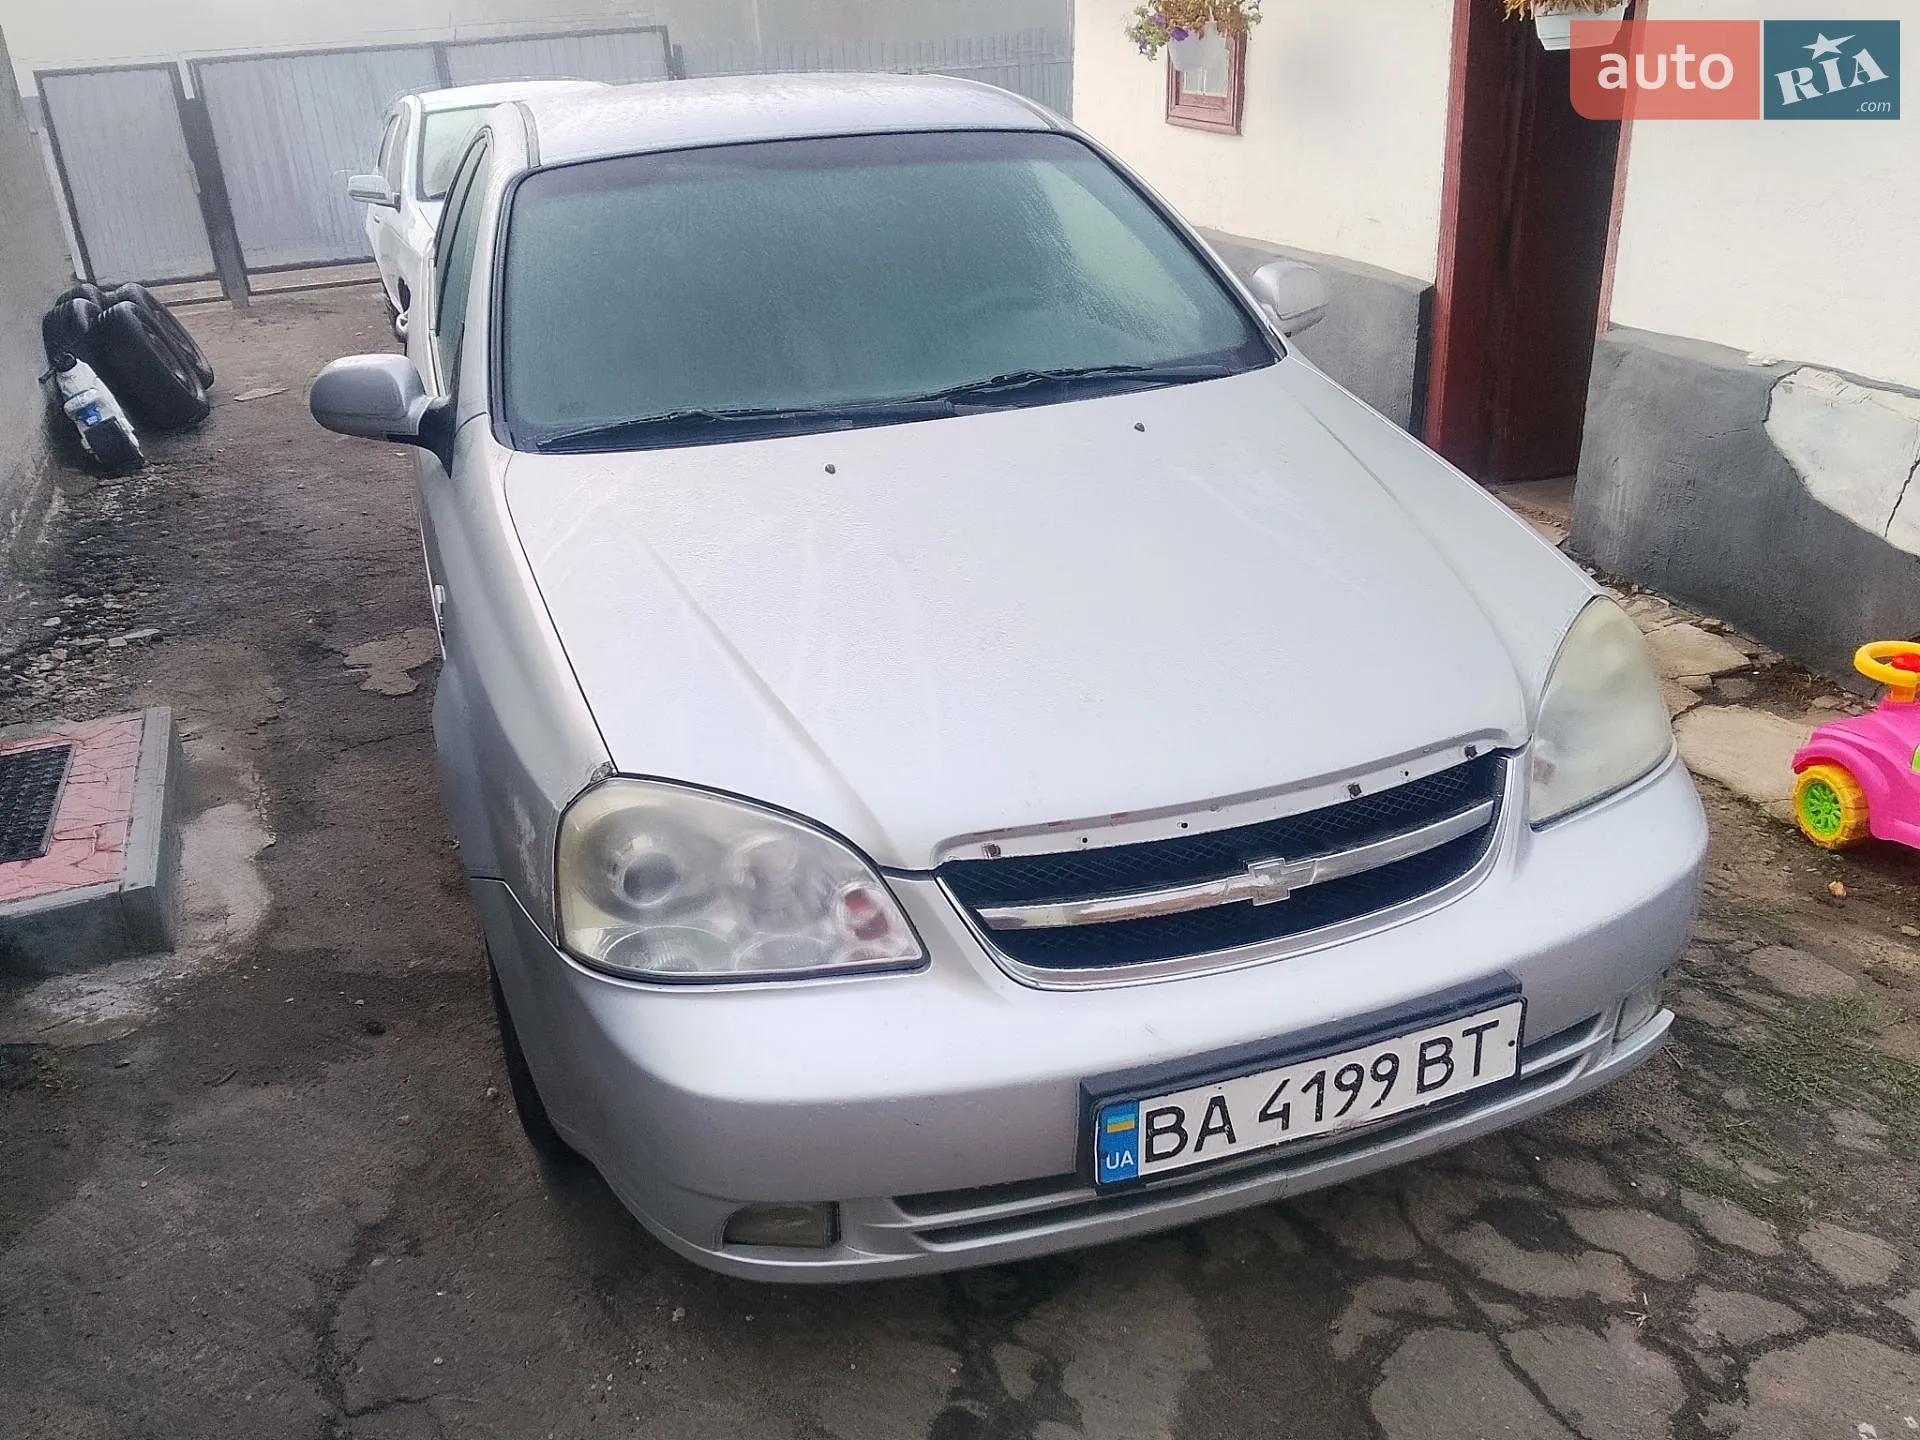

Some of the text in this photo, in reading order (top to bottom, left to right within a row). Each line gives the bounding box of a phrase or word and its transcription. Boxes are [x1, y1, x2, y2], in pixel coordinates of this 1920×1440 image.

[1144, 1019, 1500, 1163] BA 4199 BT
[1106, 1151, 1134, 1171] UA
